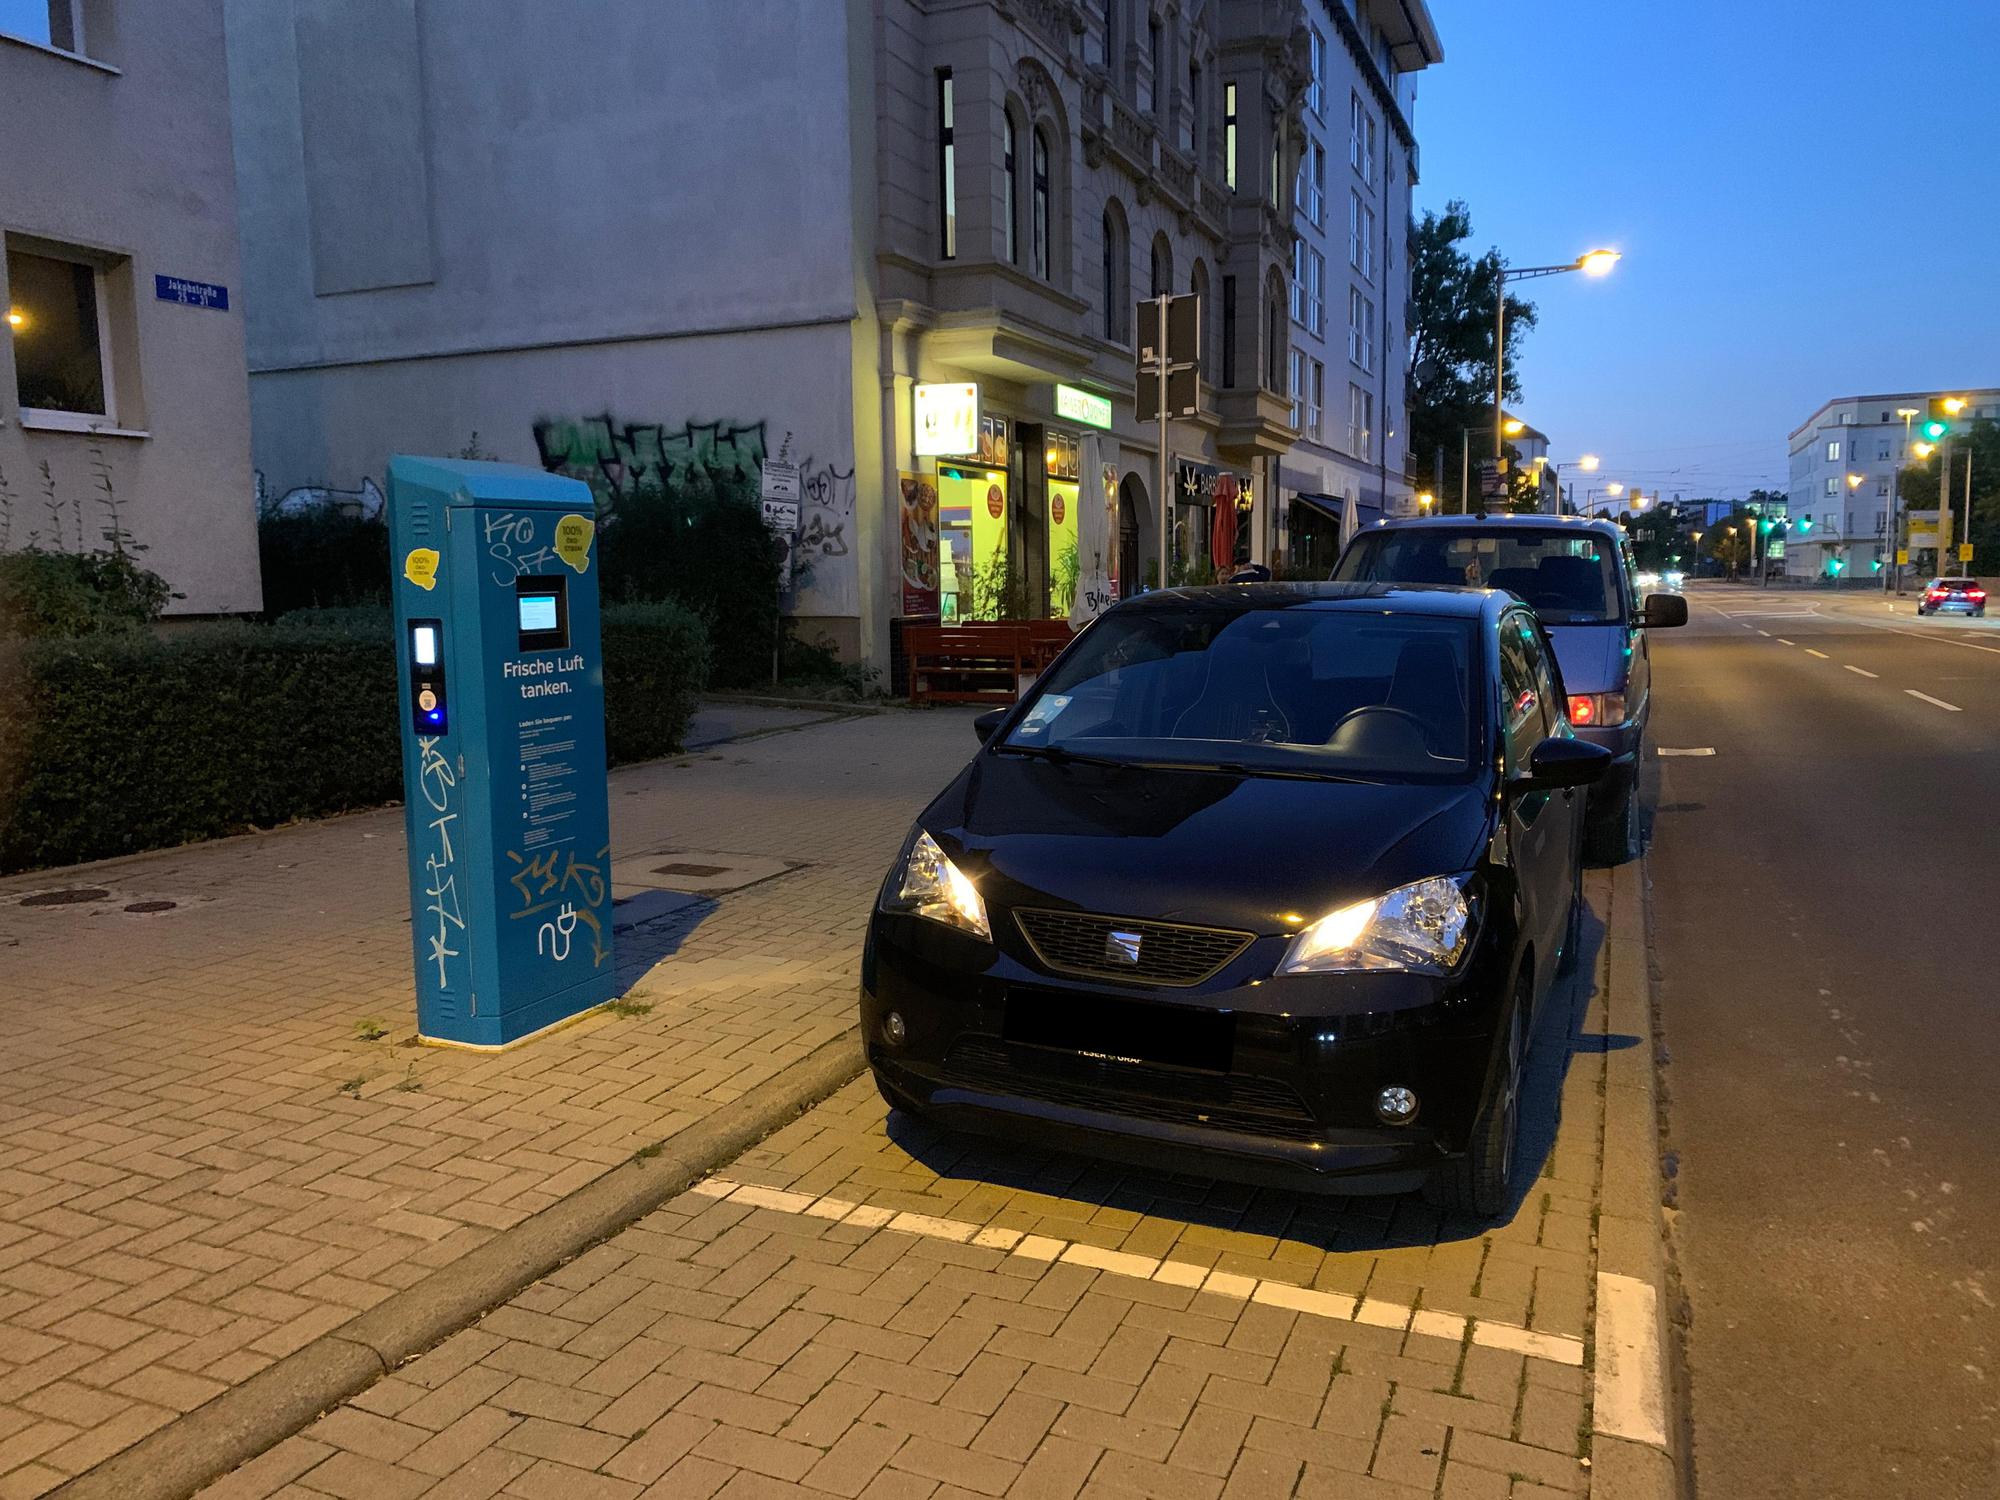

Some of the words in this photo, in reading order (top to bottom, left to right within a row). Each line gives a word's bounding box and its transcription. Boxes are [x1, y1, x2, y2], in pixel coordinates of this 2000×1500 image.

[169, 280, 217, 298] Jakobstraße
[562, 526, 582, 536] 100%
[503, 658, 554, 678] Frische
[557, 655, 585, 673] Luft
[520, 680, 572, 698] tanken.
